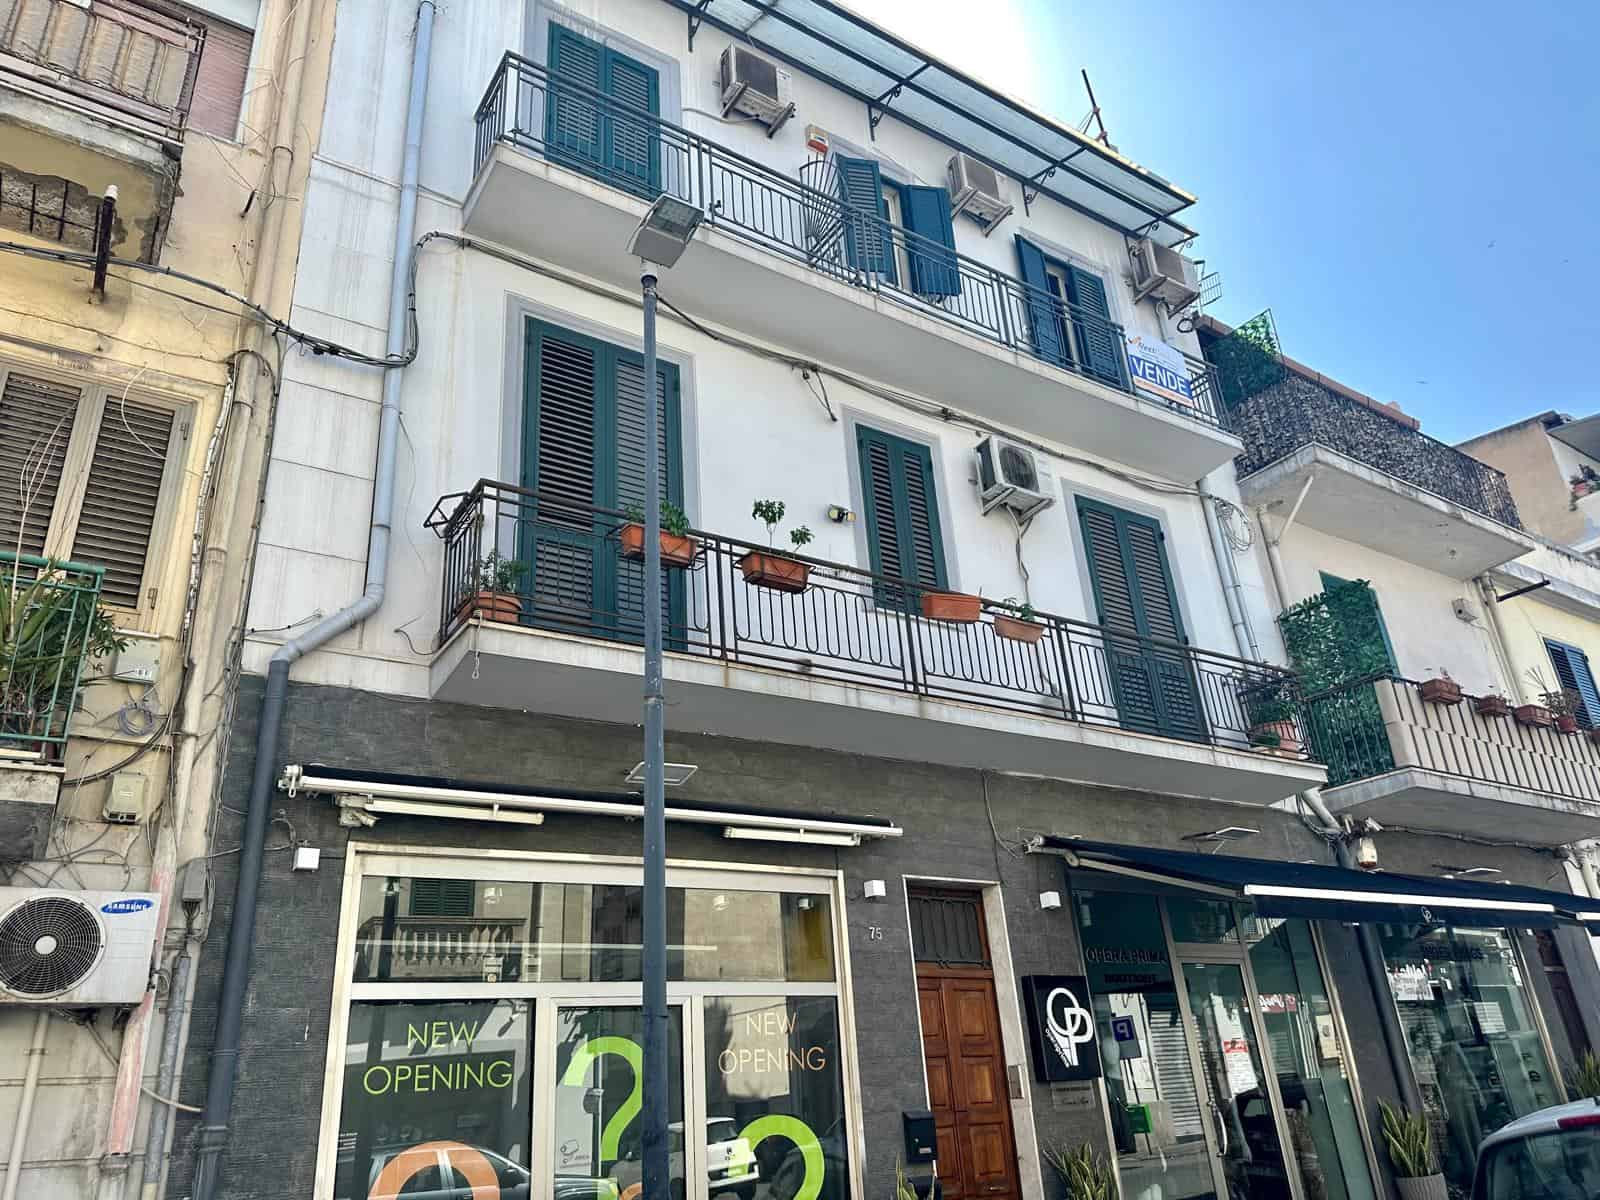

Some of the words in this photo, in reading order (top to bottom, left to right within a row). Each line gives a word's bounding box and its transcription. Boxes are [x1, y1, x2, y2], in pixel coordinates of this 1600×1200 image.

[1132, 356, 1188, 395] VENDE
[868, 926, 882, 940] 75
[407, 1021, 478, 1049] NEW
[745, 1012, 797, 1036] NEW
[718, 1046, 826, 1075] OPENING
[363, 1060, 513, 1095] OPENING
